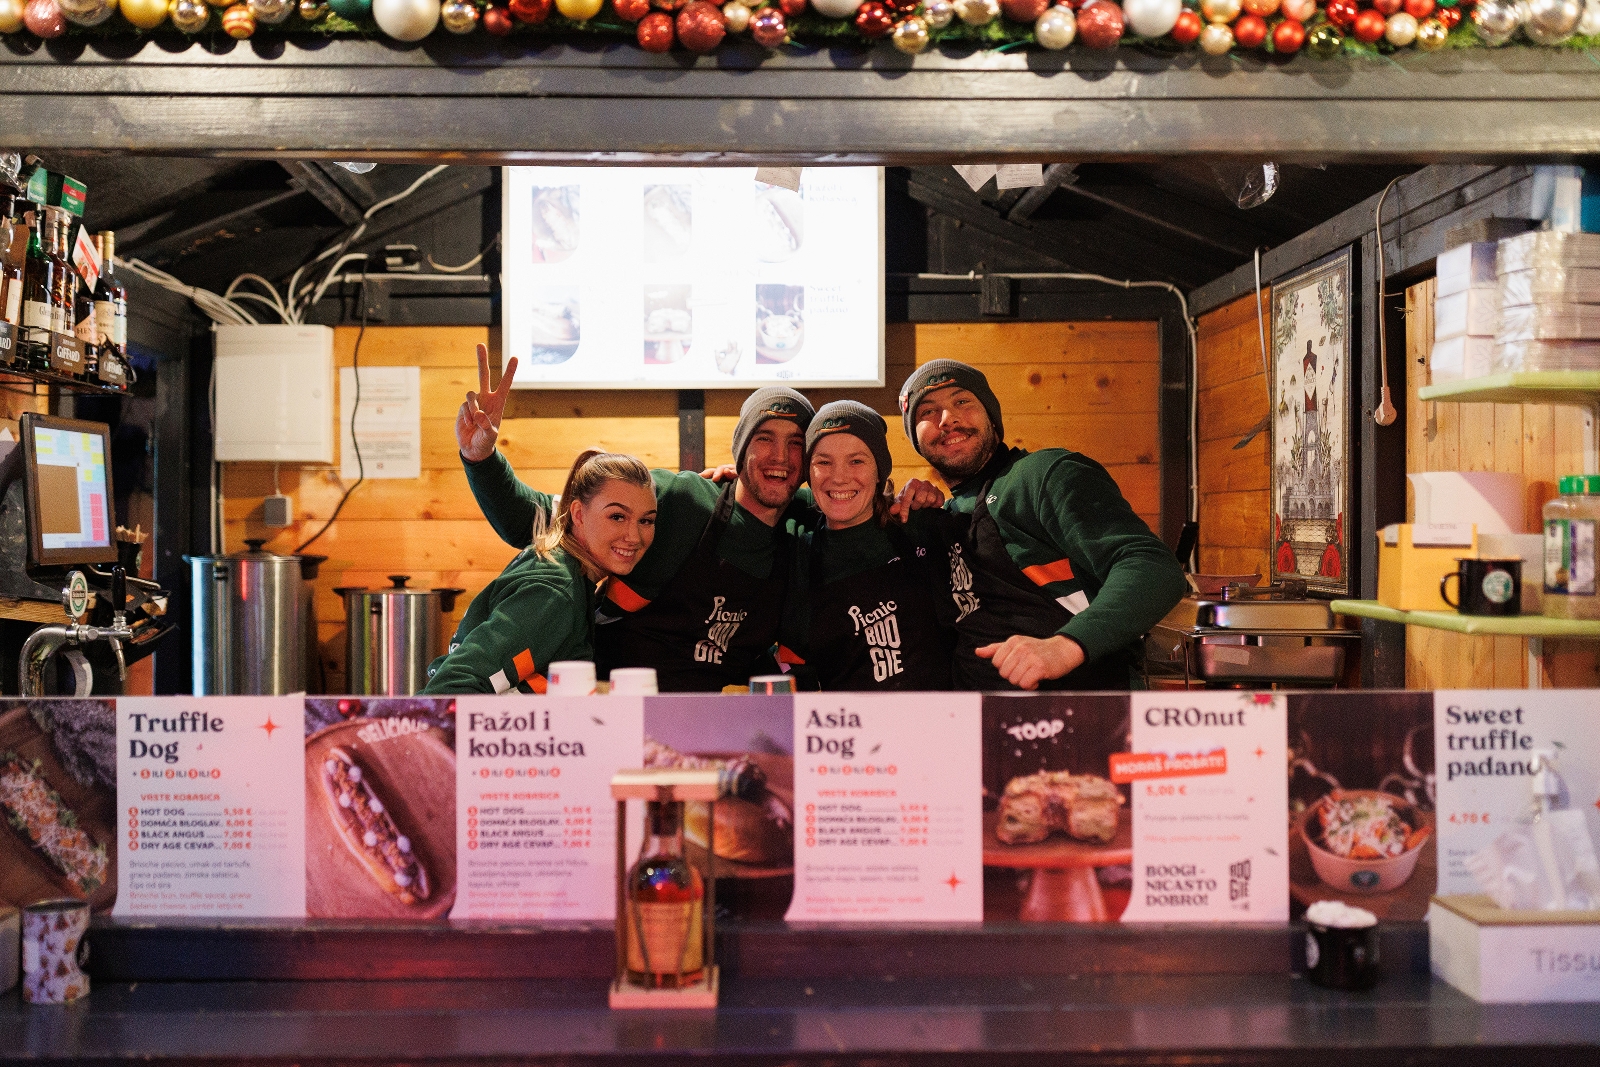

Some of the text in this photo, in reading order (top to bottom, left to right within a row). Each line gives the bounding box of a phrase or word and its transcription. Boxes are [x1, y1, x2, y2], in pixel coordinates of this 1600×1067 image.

[56, 346, 80, 363] GIFFARD
[705, 596, 748, 624] Picnic
[848, 600, 898, 636] Picnic
[865, 613, 901, 649] BOO
[869, 647, 904, 683] GIE
[128, 711, 224, 733] Truffle
[468, 710, 551, 732] Fažol i
[806, 707, 862, 729] Asia
[1145, 707, 1247, 727] CROnut
[1446, 705, 1524, 725] Sweet
[1008, 719, 1065, 741] TOOP
[1446, 729, 1533, 751] truffle
[129, 739, 179, 764] Dog
[468, 737, 586, 758] kobasica
[806, 735, 855, 759] Dog
[141, 808, 161, 816] HOT
[164, 808, 185, 816] DOG
[1448, 813, 1479, 825] 4,70
[1146, 865, 1196, 877] BOOGI
[1146, 879, 1217, 892] NICASTO
[1146, 894, 1208, 907] DOBRO!
